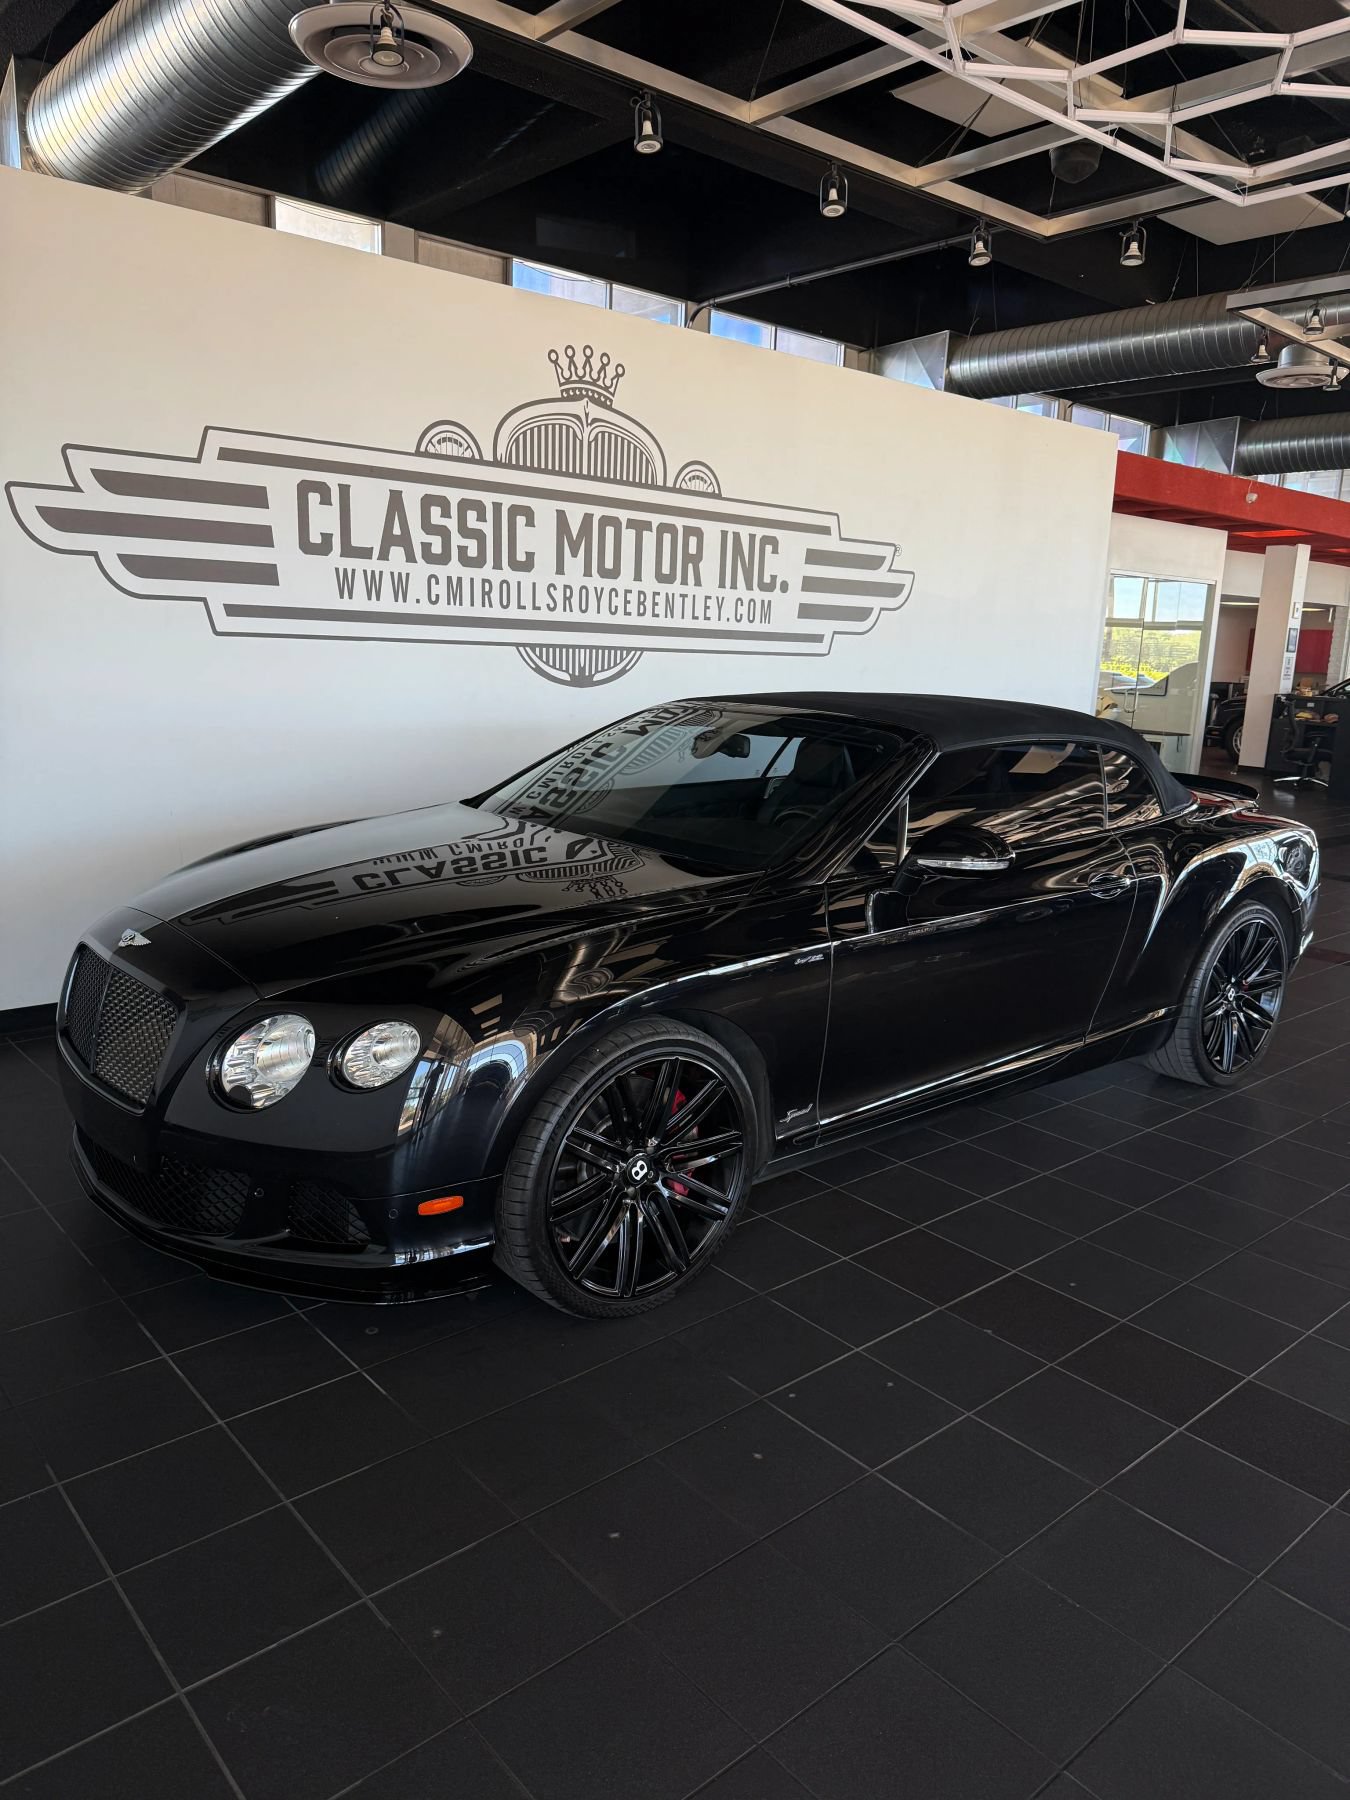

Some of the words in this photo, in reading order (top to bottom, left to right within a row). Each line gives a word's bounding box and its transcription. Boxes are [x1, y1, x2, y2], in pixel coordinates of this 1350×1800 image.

[296, 479, 536, 573] CLASSIC
[555, 509, 705, 588] MOTOR
[717, 529, 790, 594] INC.
[334, 566, 773, 625] WWW.CMIROLLSROYCEBENTLEY.COM
[631, 1159, 648, 1181] B
